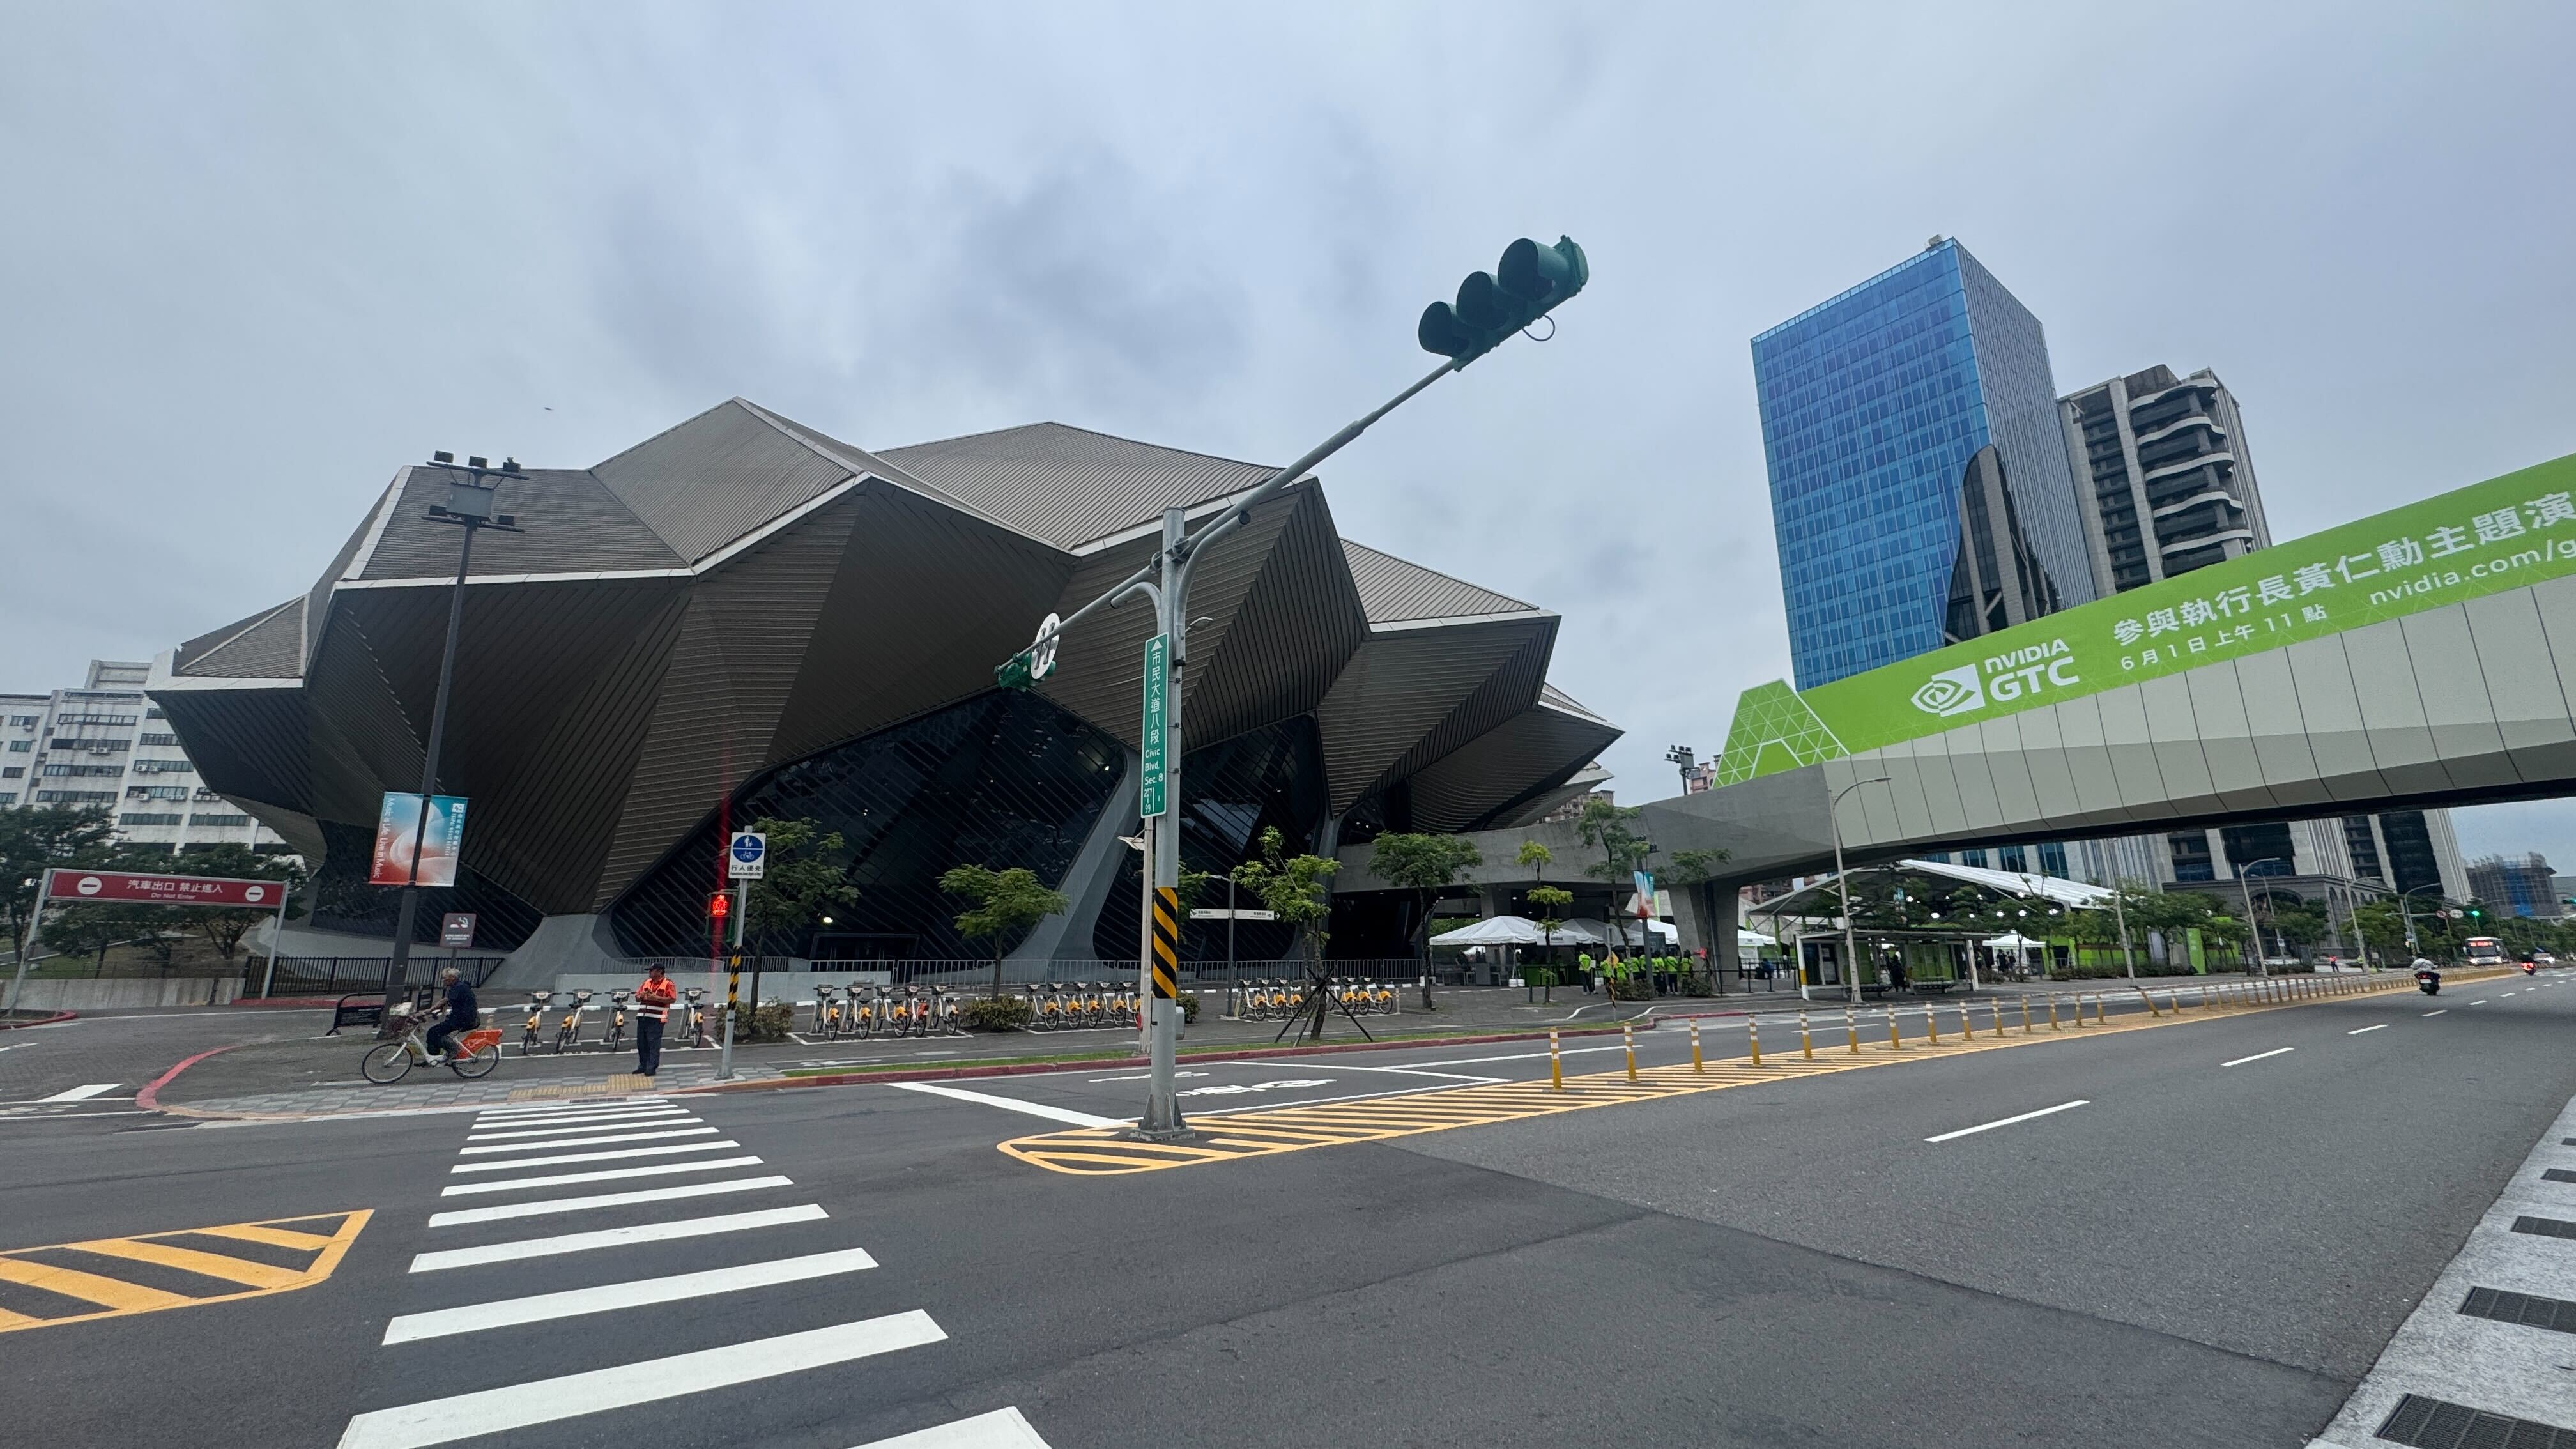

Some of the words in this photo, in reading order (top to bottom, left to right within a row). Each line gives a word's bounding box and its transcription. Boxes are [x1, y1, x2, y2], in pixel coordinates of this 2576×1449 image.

[1989, 656, 2080, 702] GTC
[1150, 651, 1162, 746] 市民大道八段
[1145, 748, 1160, 758] Civic
[1145, 760, 1160, 772] Blvd.
[1144, 776, 1157, 785] Sec.
[1158, 772, 1163, 782] 8
[373, 859, 384, 878] Music
[126, 879, 176, 891] 汽車出口
[179, 882, 224, 893] 禁止進入
